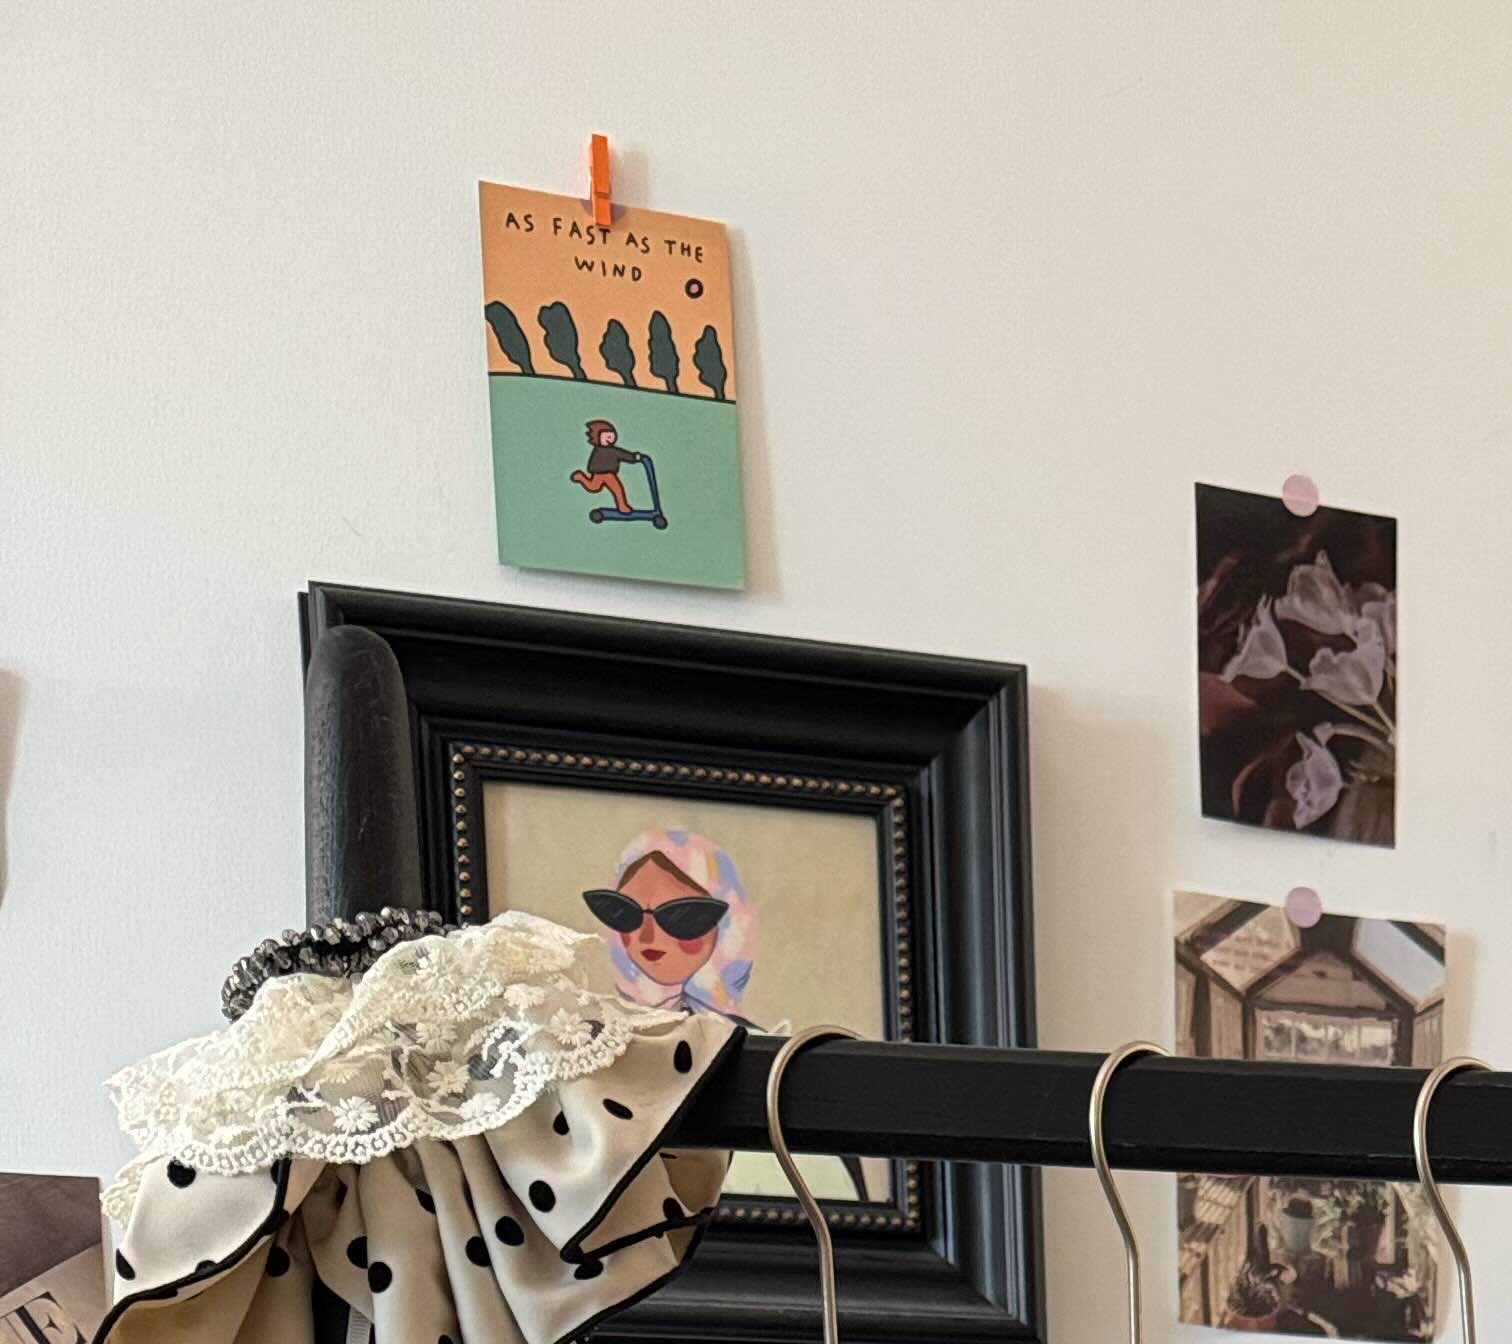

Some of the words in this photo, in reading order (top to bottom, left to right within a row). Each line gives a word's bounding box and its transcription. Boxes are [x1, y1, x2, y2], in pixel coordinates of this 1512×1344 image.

[505, 212, 534, 233] AS
[552, 217, 610, 245] FAST
[625, 235, 651, 254] AS
[664, 239, 704, 263] THE
[574, 256, 642, 282] WIND
